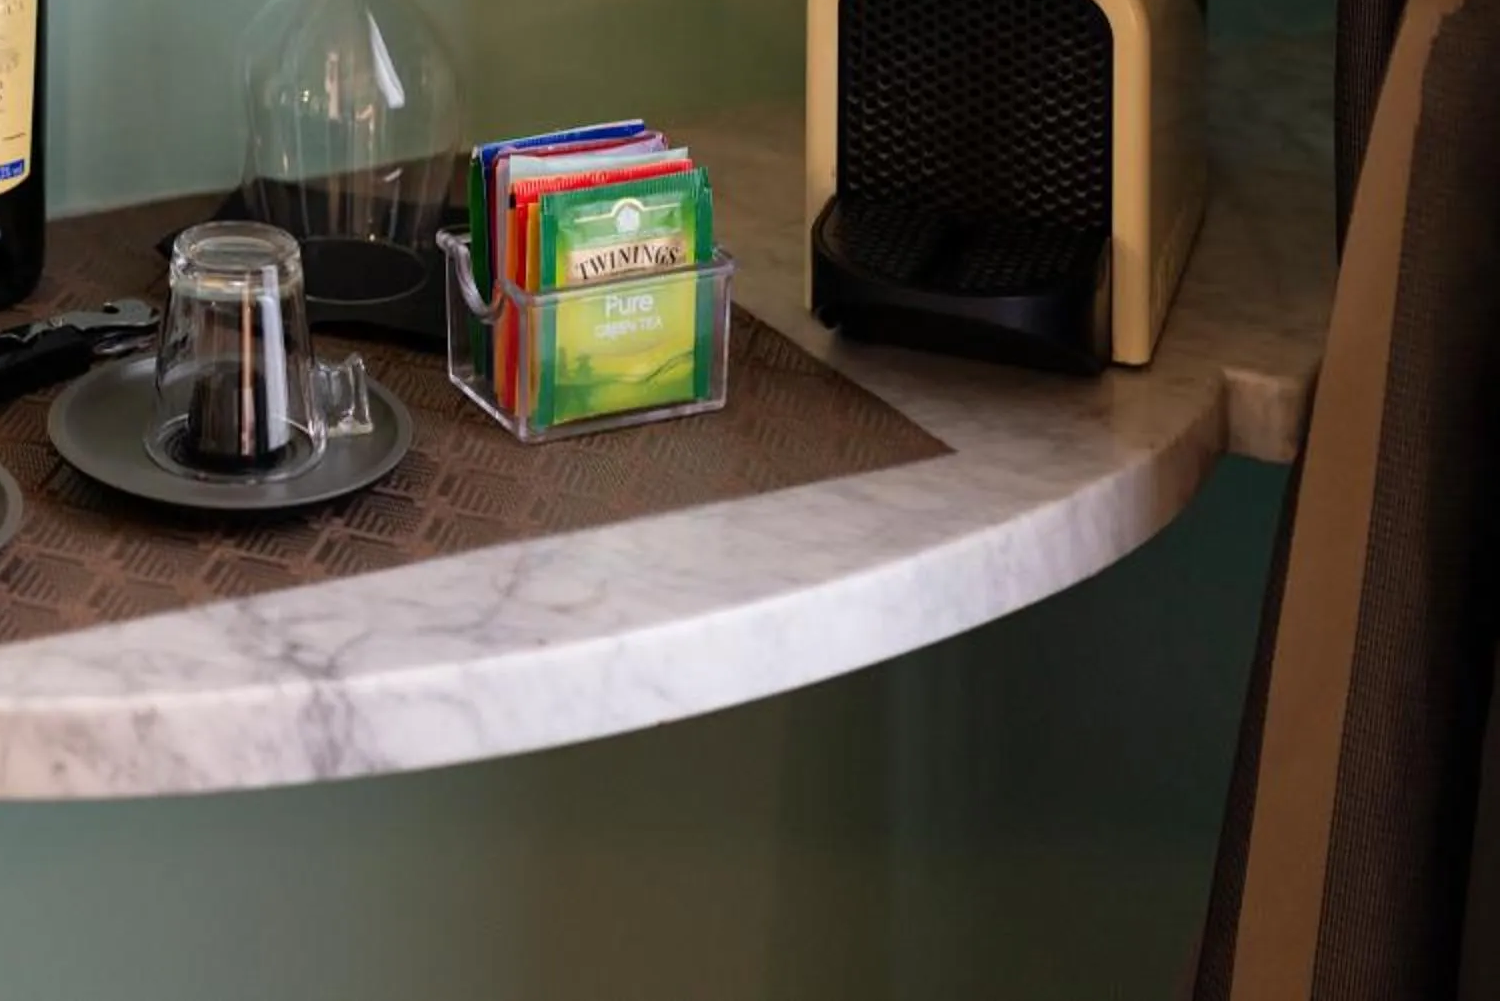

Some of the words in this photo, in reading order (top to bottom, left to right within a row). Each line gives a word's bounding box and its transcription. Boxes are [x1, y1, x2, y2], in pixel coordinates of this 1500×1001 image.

[575, 244, 681, 280] TWININGS
[604, 293, 655, 318] Pure
[640, 315, 664, 331] TEA
